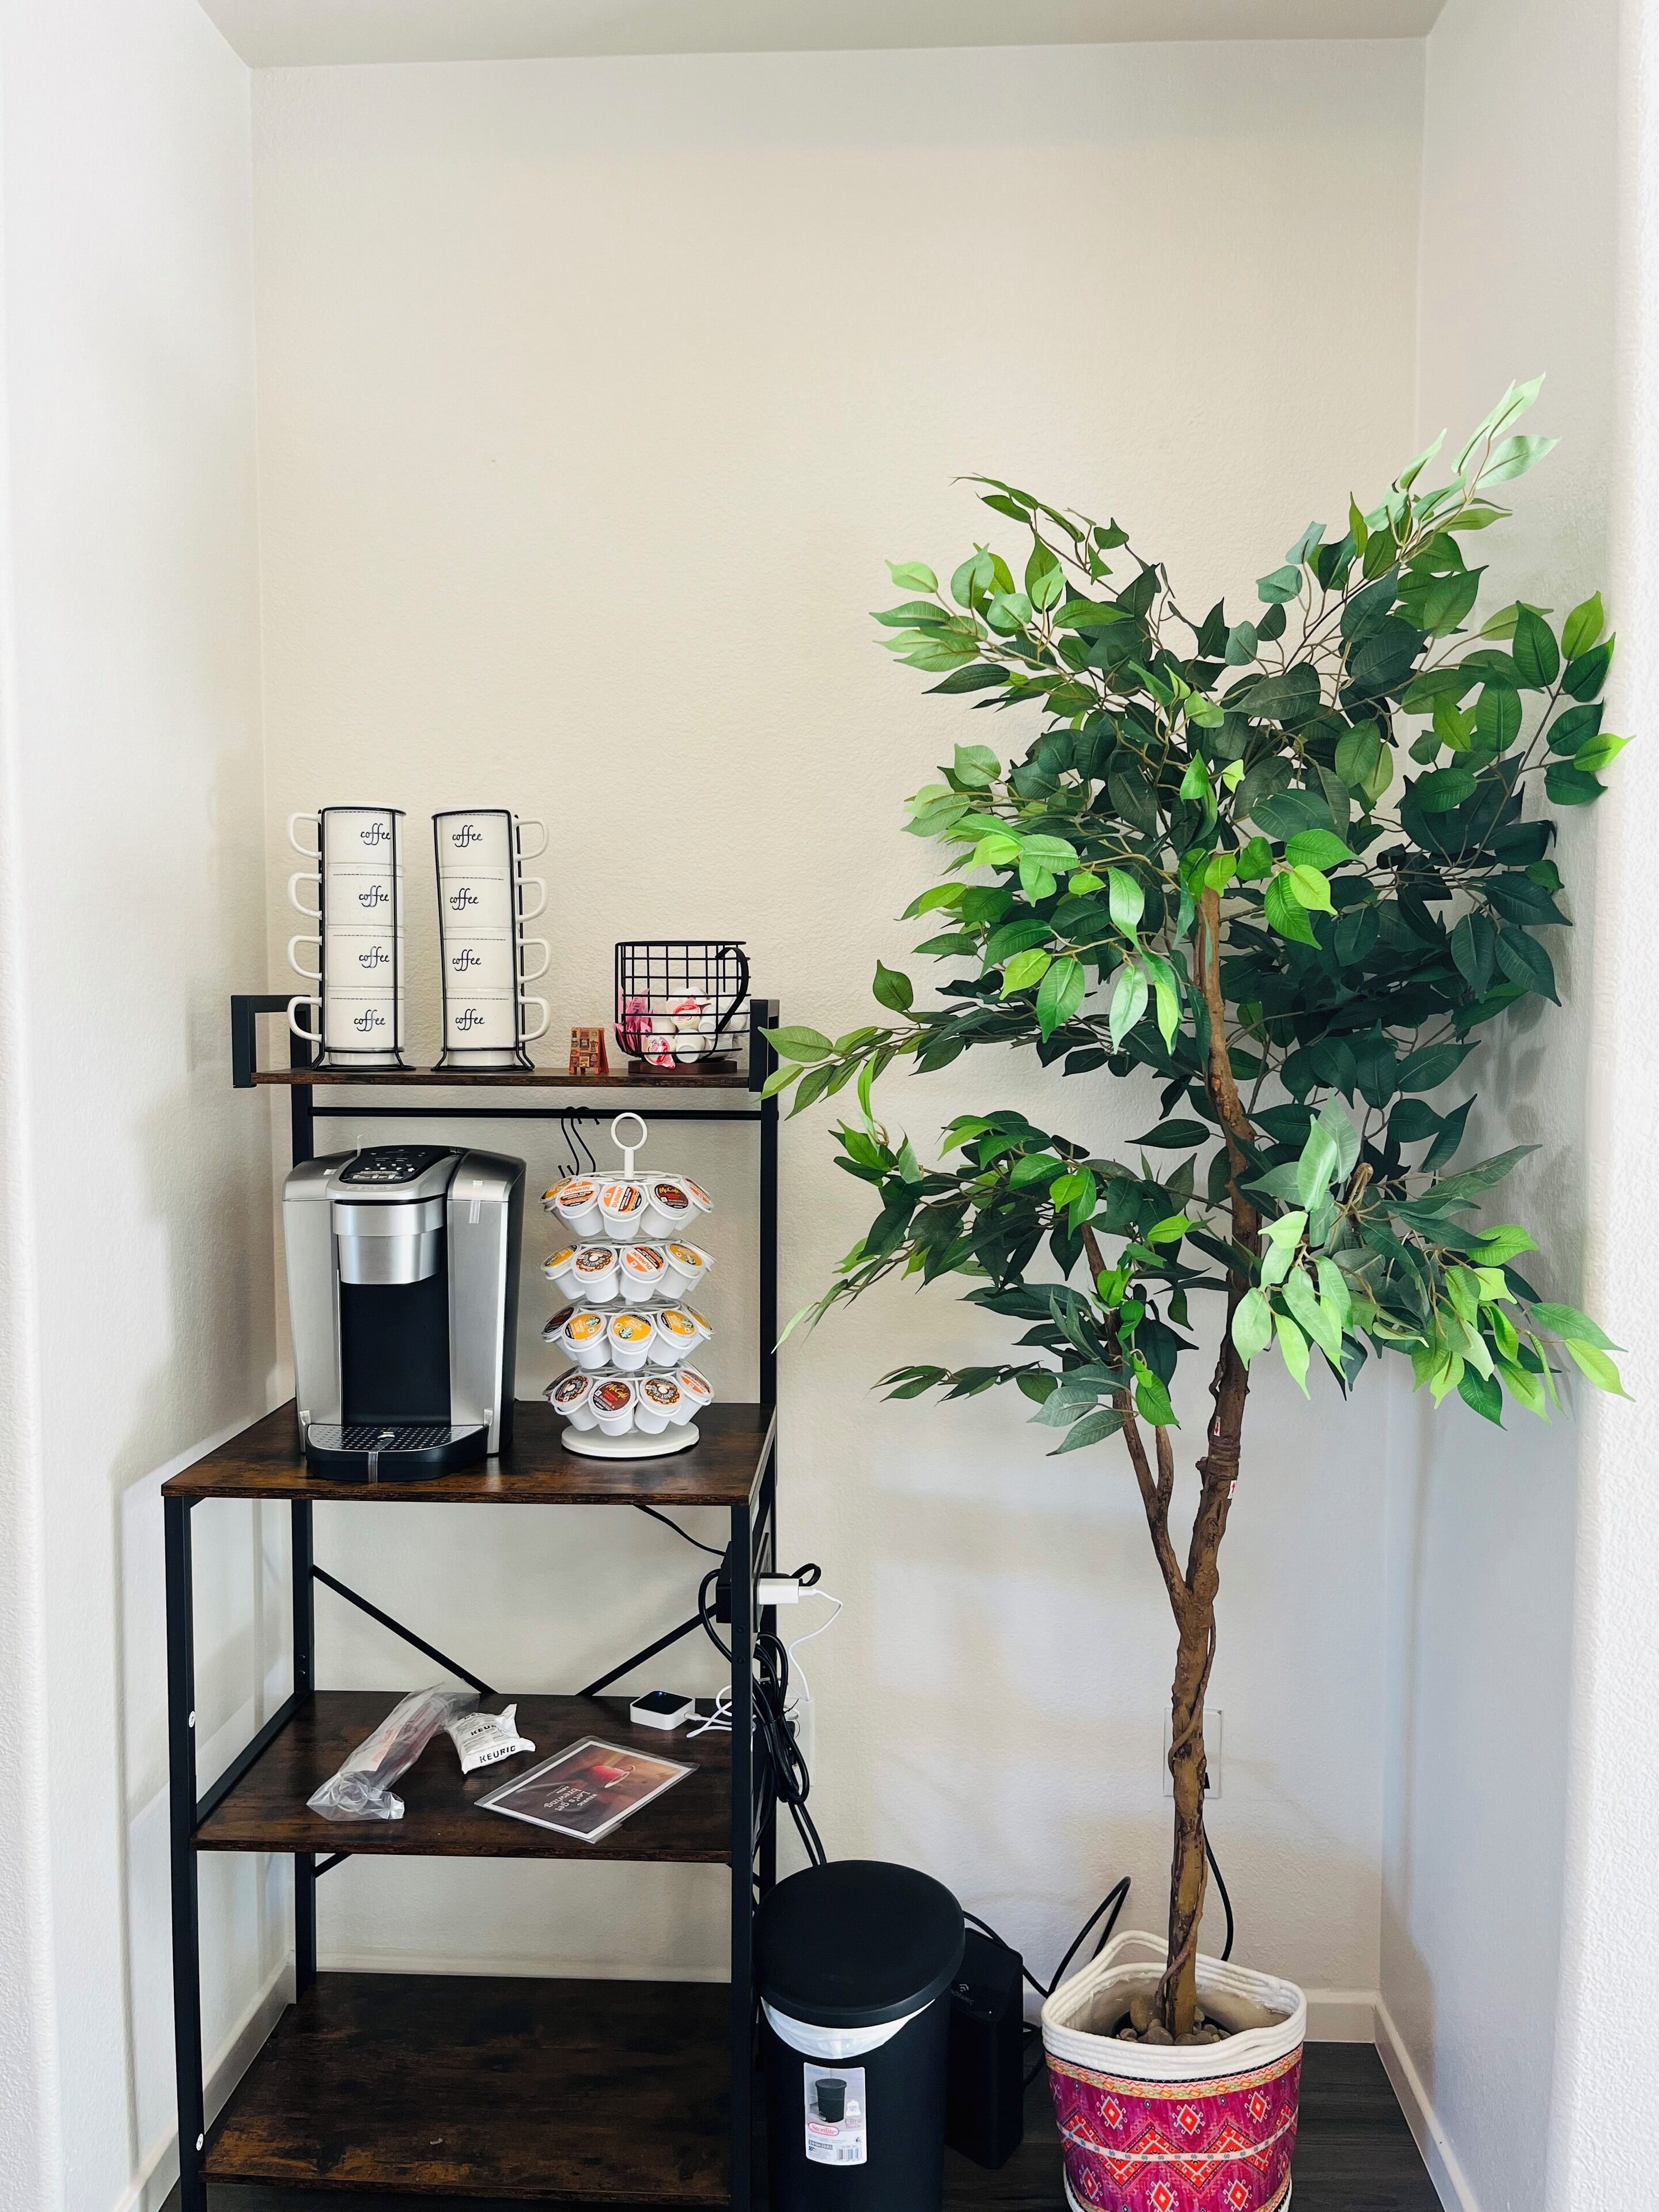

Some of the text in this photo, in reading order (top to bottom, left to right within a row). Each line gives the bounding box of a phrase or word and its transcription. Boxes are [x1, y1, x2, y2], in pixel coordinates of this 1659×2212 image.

[360, 823, 391, 846] coffee
[452, 825, 483, 847] coffee
[359, 885, 389, 908] coffee
[450, 888, 479, 910] coffee
[359, 946, 390, 968] coffee
[452, 949, 482, 971] coffee
[354, 1009, 386, 1032] coffee
[455, 1009, 485, 1031] coffee
[479, 1745, 516, 1763] KEURIG
[554, 1790, 591, 1812] Let's get
